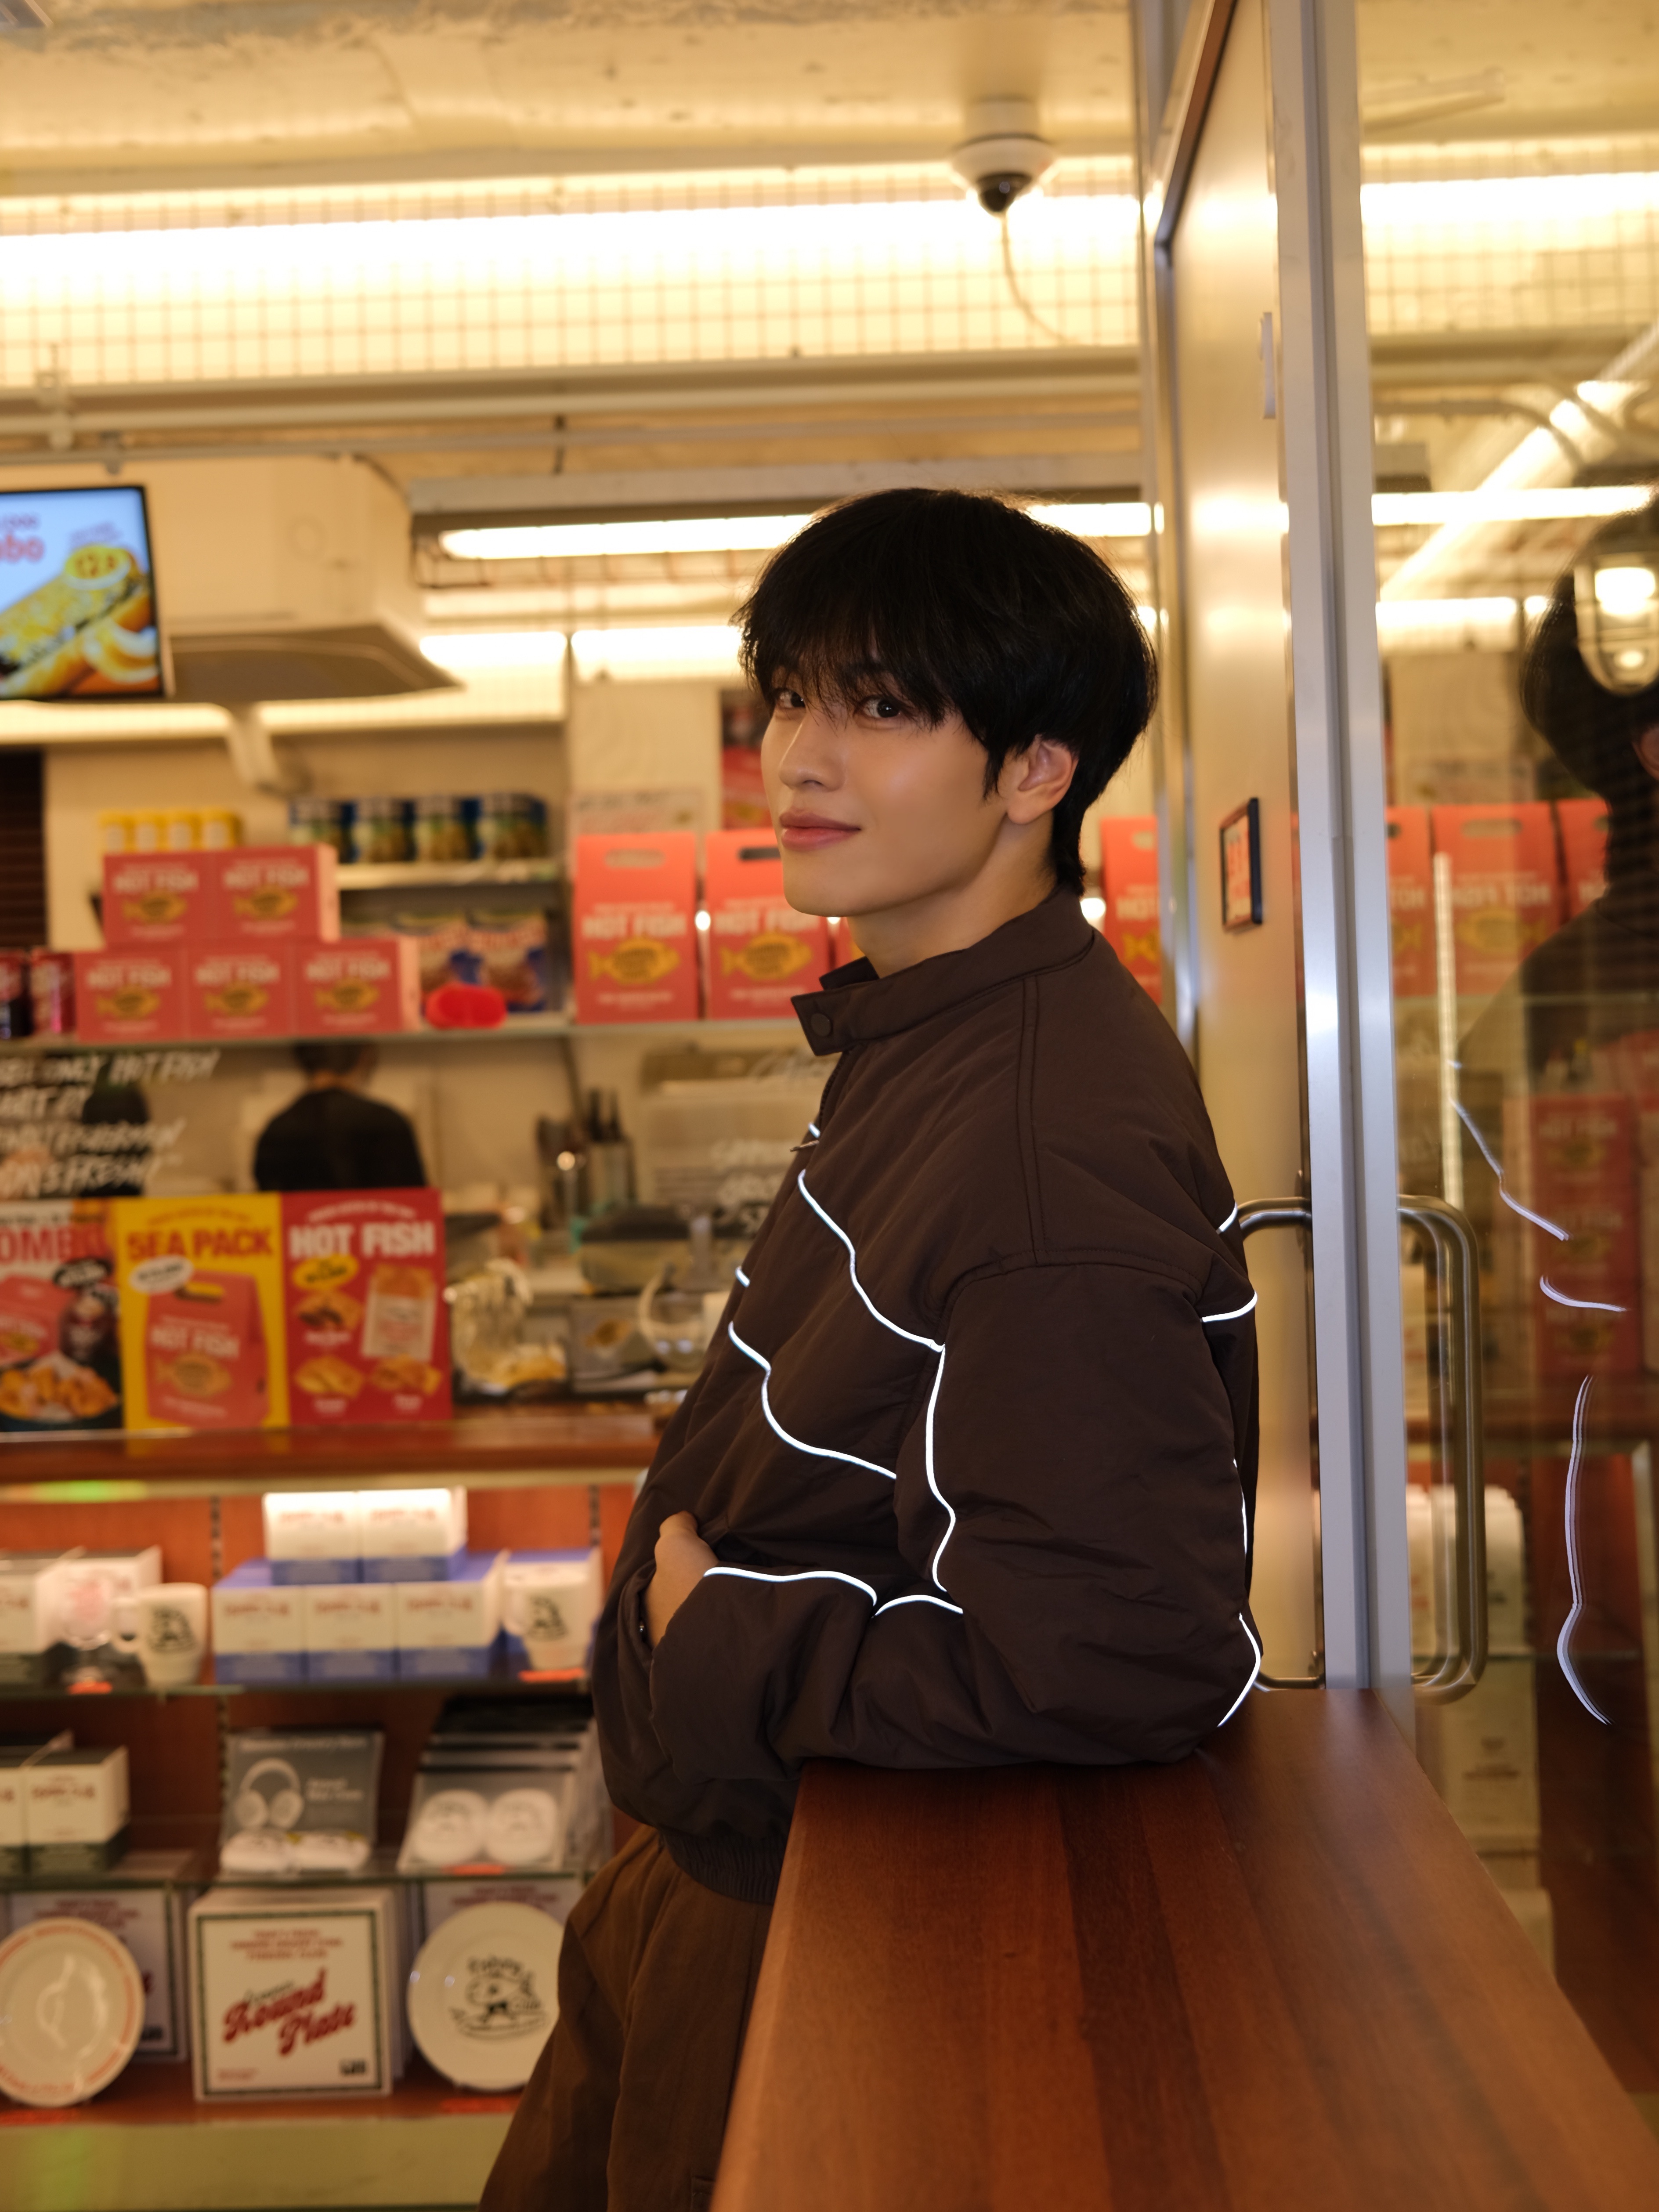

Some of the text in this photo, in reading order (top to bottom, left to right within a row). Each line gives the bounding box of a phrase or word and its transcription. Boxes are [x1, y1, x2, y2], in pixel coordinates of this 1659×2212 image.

[128, 1227, 272, 1261] SEA PACK
[288, 1221, 436, 1260] HOT FISH
